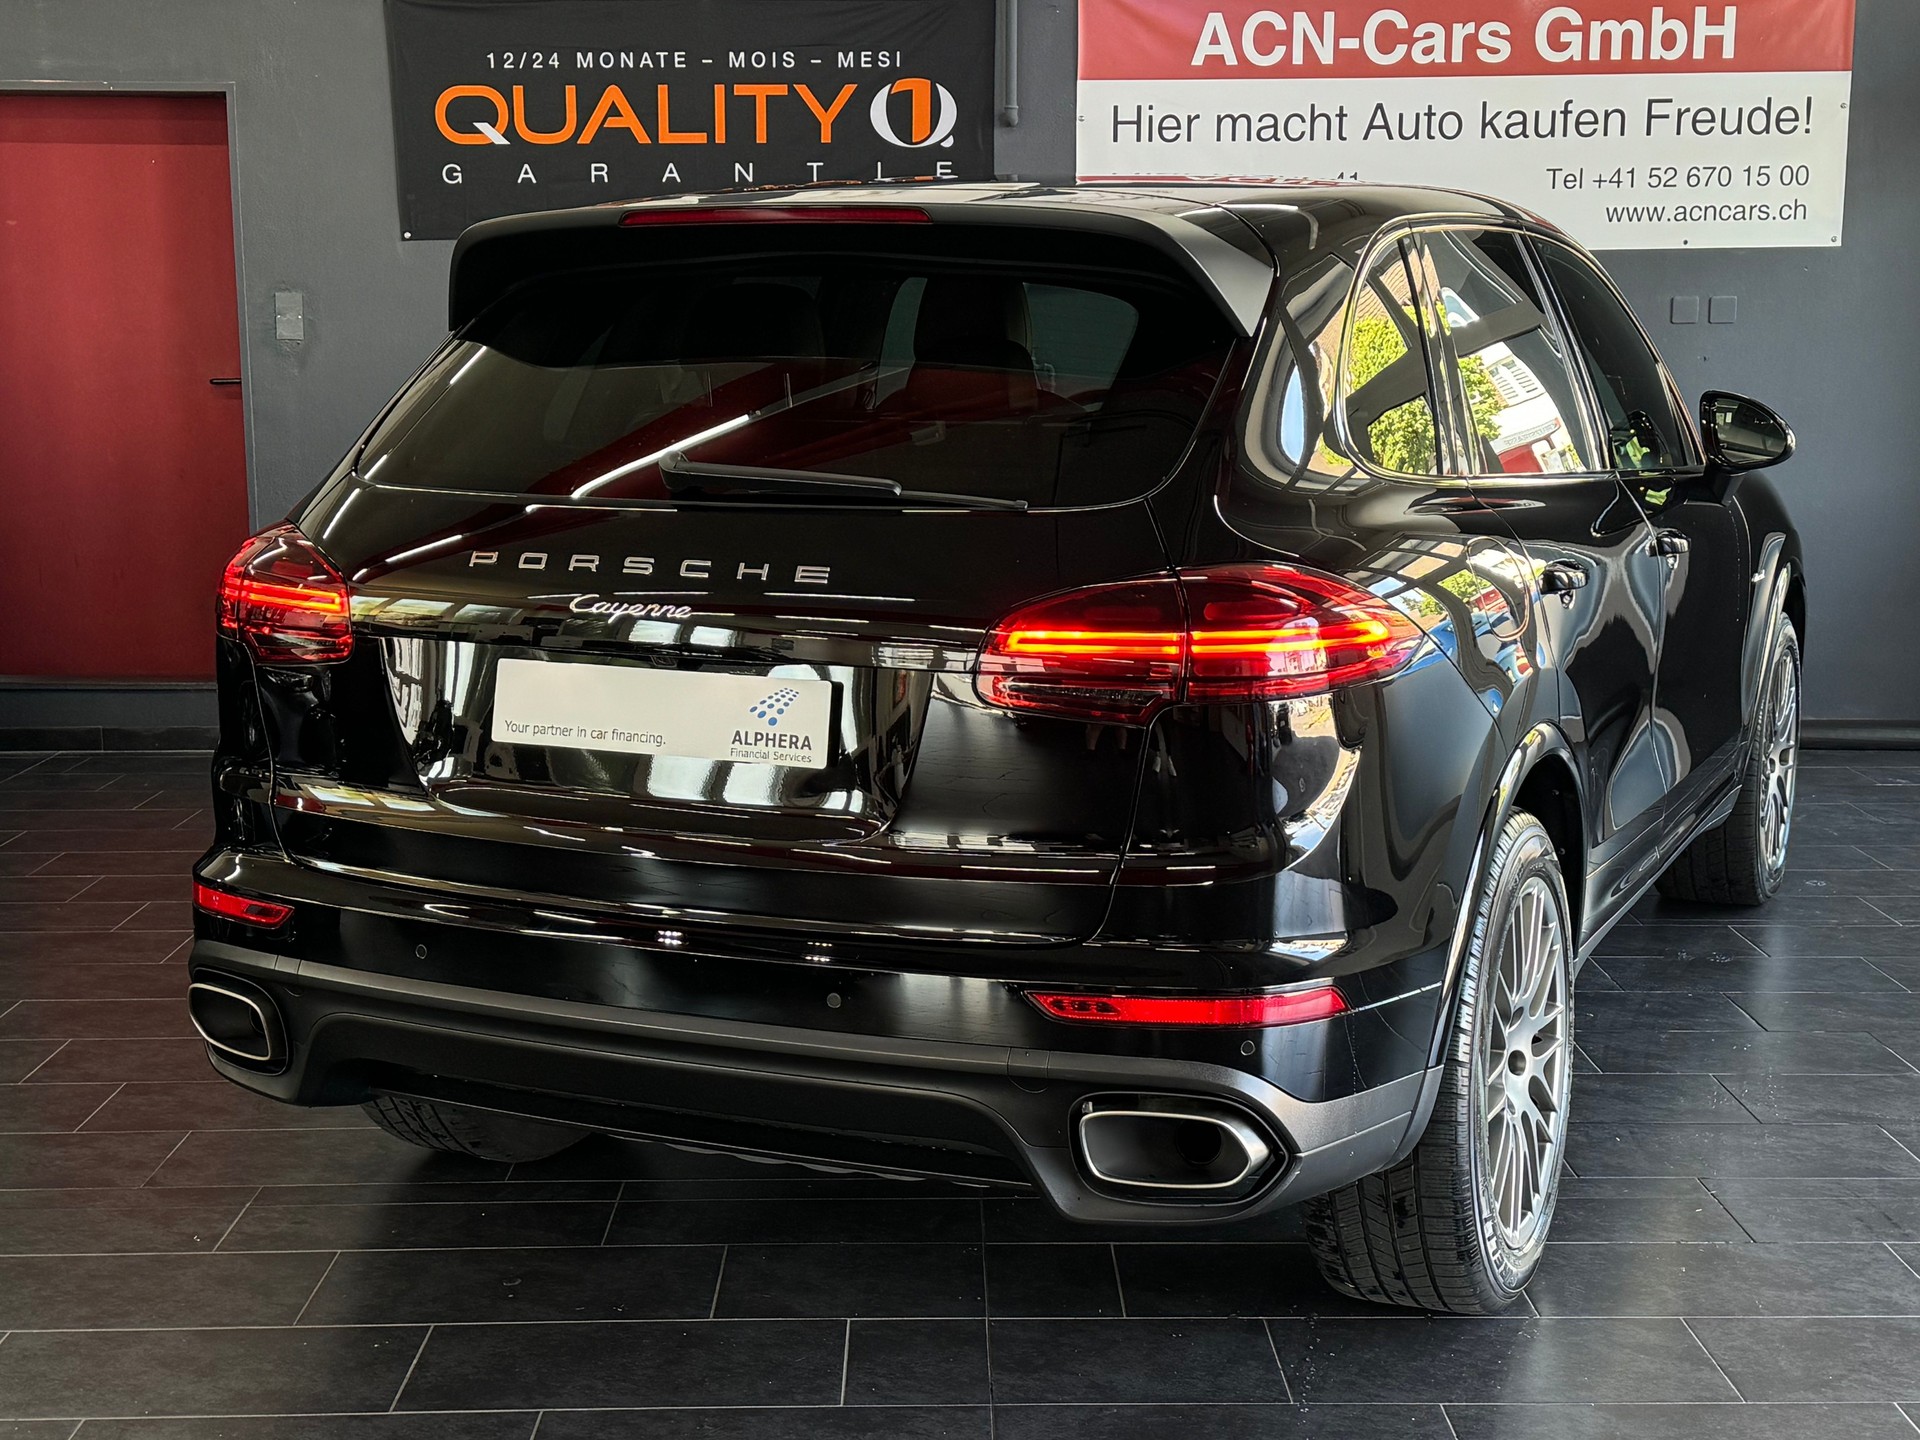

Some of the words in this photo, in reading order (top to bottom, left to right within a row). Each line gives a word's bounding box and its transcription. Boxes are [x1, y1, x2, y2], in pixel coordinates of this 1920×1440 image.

[1190, 9, 1512, 67] ACN-Cars
[1534, 5, 1737, 63] GmbH
[486, 51, 560, 70] 12/24
[576, 51, 687, 69] MONATE
[728, 50, 796, 69] MOIS
[837, 50, 902, 69] MESI
[434, 83, 858, 146] QUALITY
[1112, 104, 1201, 143] Hier
[1216, 103, 1348, 142] macht
[1362, 102, 1463, 141] Auto
[1480, 99, 1626, 139] kaufen
[1645, 96, 1812, 137] Freude!
[1546, 167, 1584, 190] Tel
[1592, 167, 1635, 189] +41
[1647, 166, 1678, 188] 52
[1686, 165, 1732, 188] 670
[1742, 165, 1772, 187] 15
[1779, 164, 1810, 186] 00
[1605, 198, 1807, 223] www.acncars.ch
[468, 550, 831, 585] PORSCHE
[569, 594, 692, 624] Cayenne
[504, 720, 530, 733] Your
[532, 724, 573, 737] partner
[577, 726, 587, 738] in
[590, 729, 608, 740] car
[612, 728, 666, 747] financing.
[731, 730, 812, 751] ALPHERA
[730, 747, 770, 760] Financial
[773, 751, 812, 763] Services
